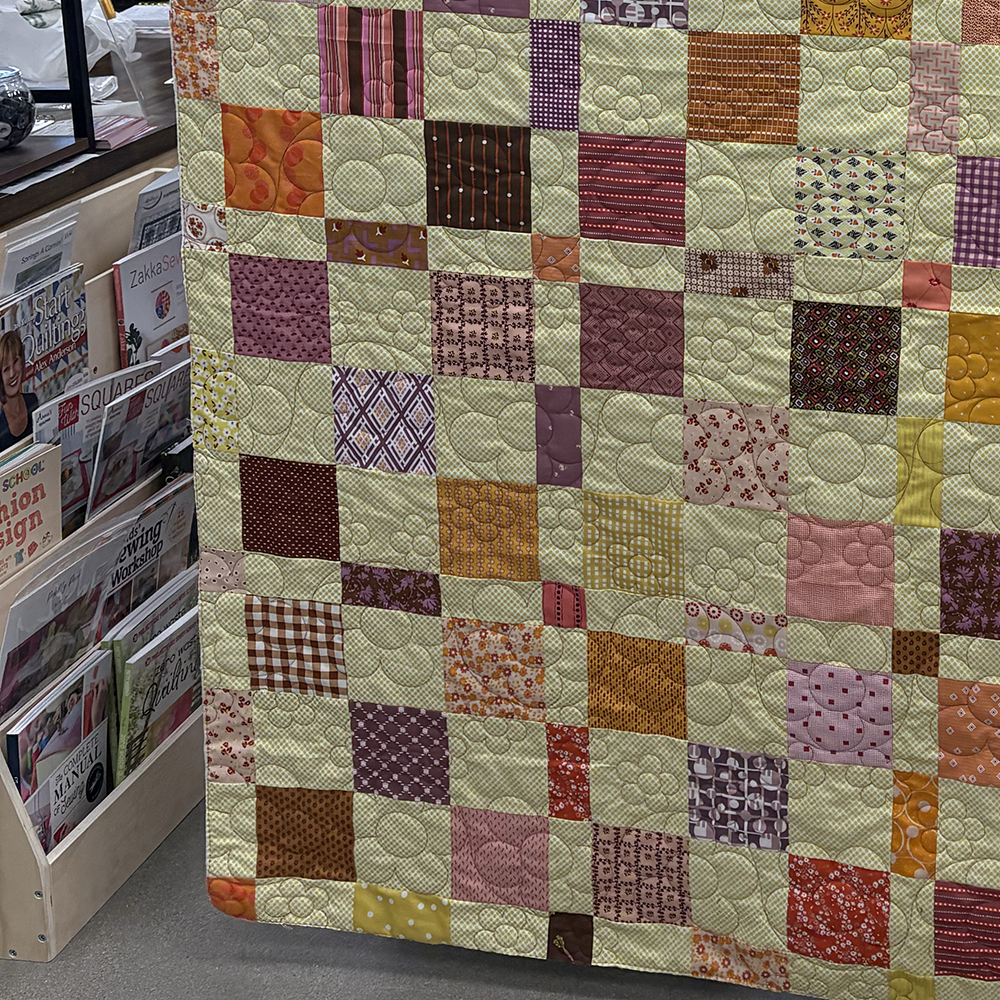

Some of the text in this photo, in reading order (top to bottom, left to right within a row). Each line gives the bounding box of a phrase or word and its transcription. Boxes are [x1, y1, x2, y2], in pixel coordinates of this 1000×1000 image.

[34, 286, 70, 326] Start
[22, 308, 86, 366] Quilting
[34, 361, 47, 373] Alex
[49, 342, 77, 365] Anderson
[2, 461, 45, 492] SCHOOL
[112, 540, 164, 588] Workshop
[178, 633, 199, 655] wast
[63, 732, 99, 776] COMPLETE
[54, 744, 102, 807] MANUAL
